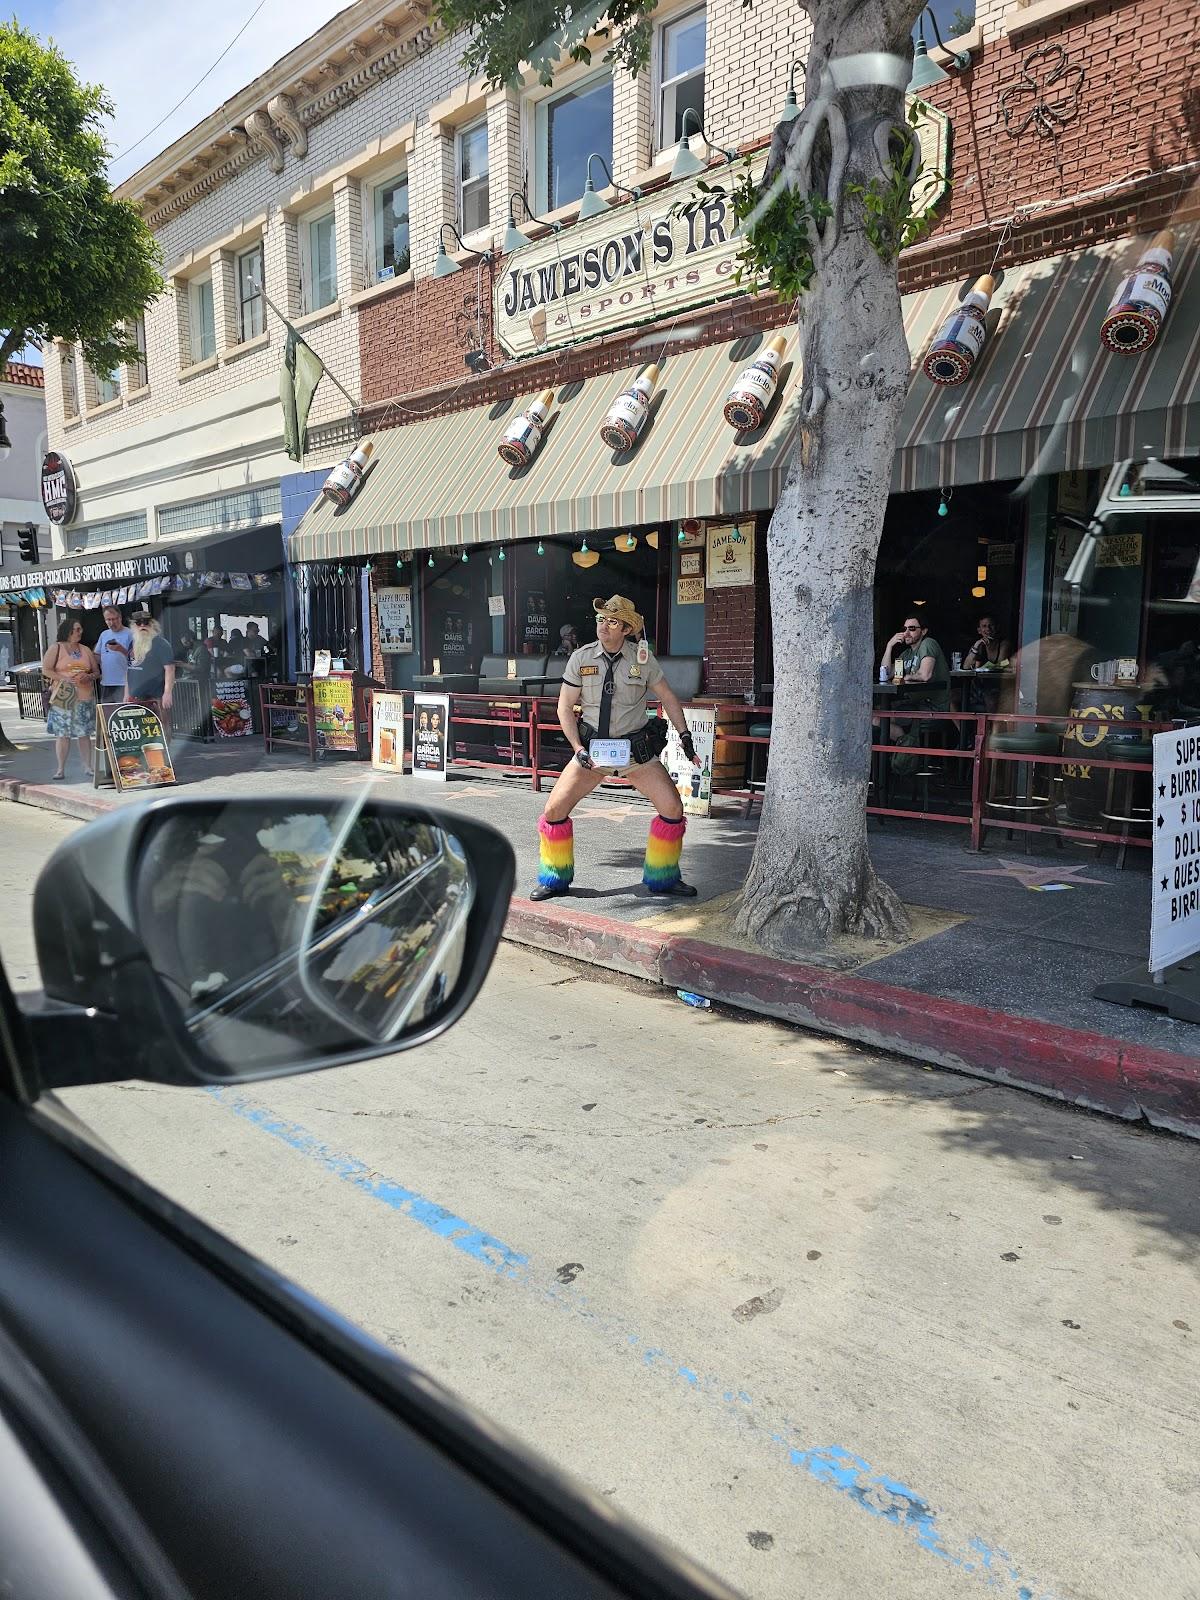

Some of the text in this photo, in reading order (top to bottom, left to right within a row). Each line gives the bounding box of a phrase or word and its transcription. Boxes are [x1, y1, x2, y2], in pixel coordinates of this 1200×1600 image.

[504, 213, 674, 317] JAMESON'S
[554, 259, 734, 326] & SPORTS G
[712, 534, 748, 549] JAMESON
[11, 574, 26, 589] COLD
[27, 571, 43, 588] BEER
[44, 567, 81, 585] COCKTAILS
[82, 563, 112, 581] SPORTS
[114, 558, 141, 578] HAPPY
[144, 555, 168, 575] HOUR
[527, 615, 547, 624] DAVIS
[444, 633, 463, 641] DAVIS
[525, 626, 549, 635] GARCIA
[443, 643, 465, 651] GARCIA
[216, 681, 244, 689] WINGS
[111, 718, 139, 732] ALL
[692, 720, 713, 734] HOUR
[112, 729, 141, 742] FOOD
[418, 732, 439, 743] DAVIS
[416, 744, 441, 756] GARCIA
[1174, 859, 1200, 890] QUES
[1171, 888, 1199, 922] BIRRI
